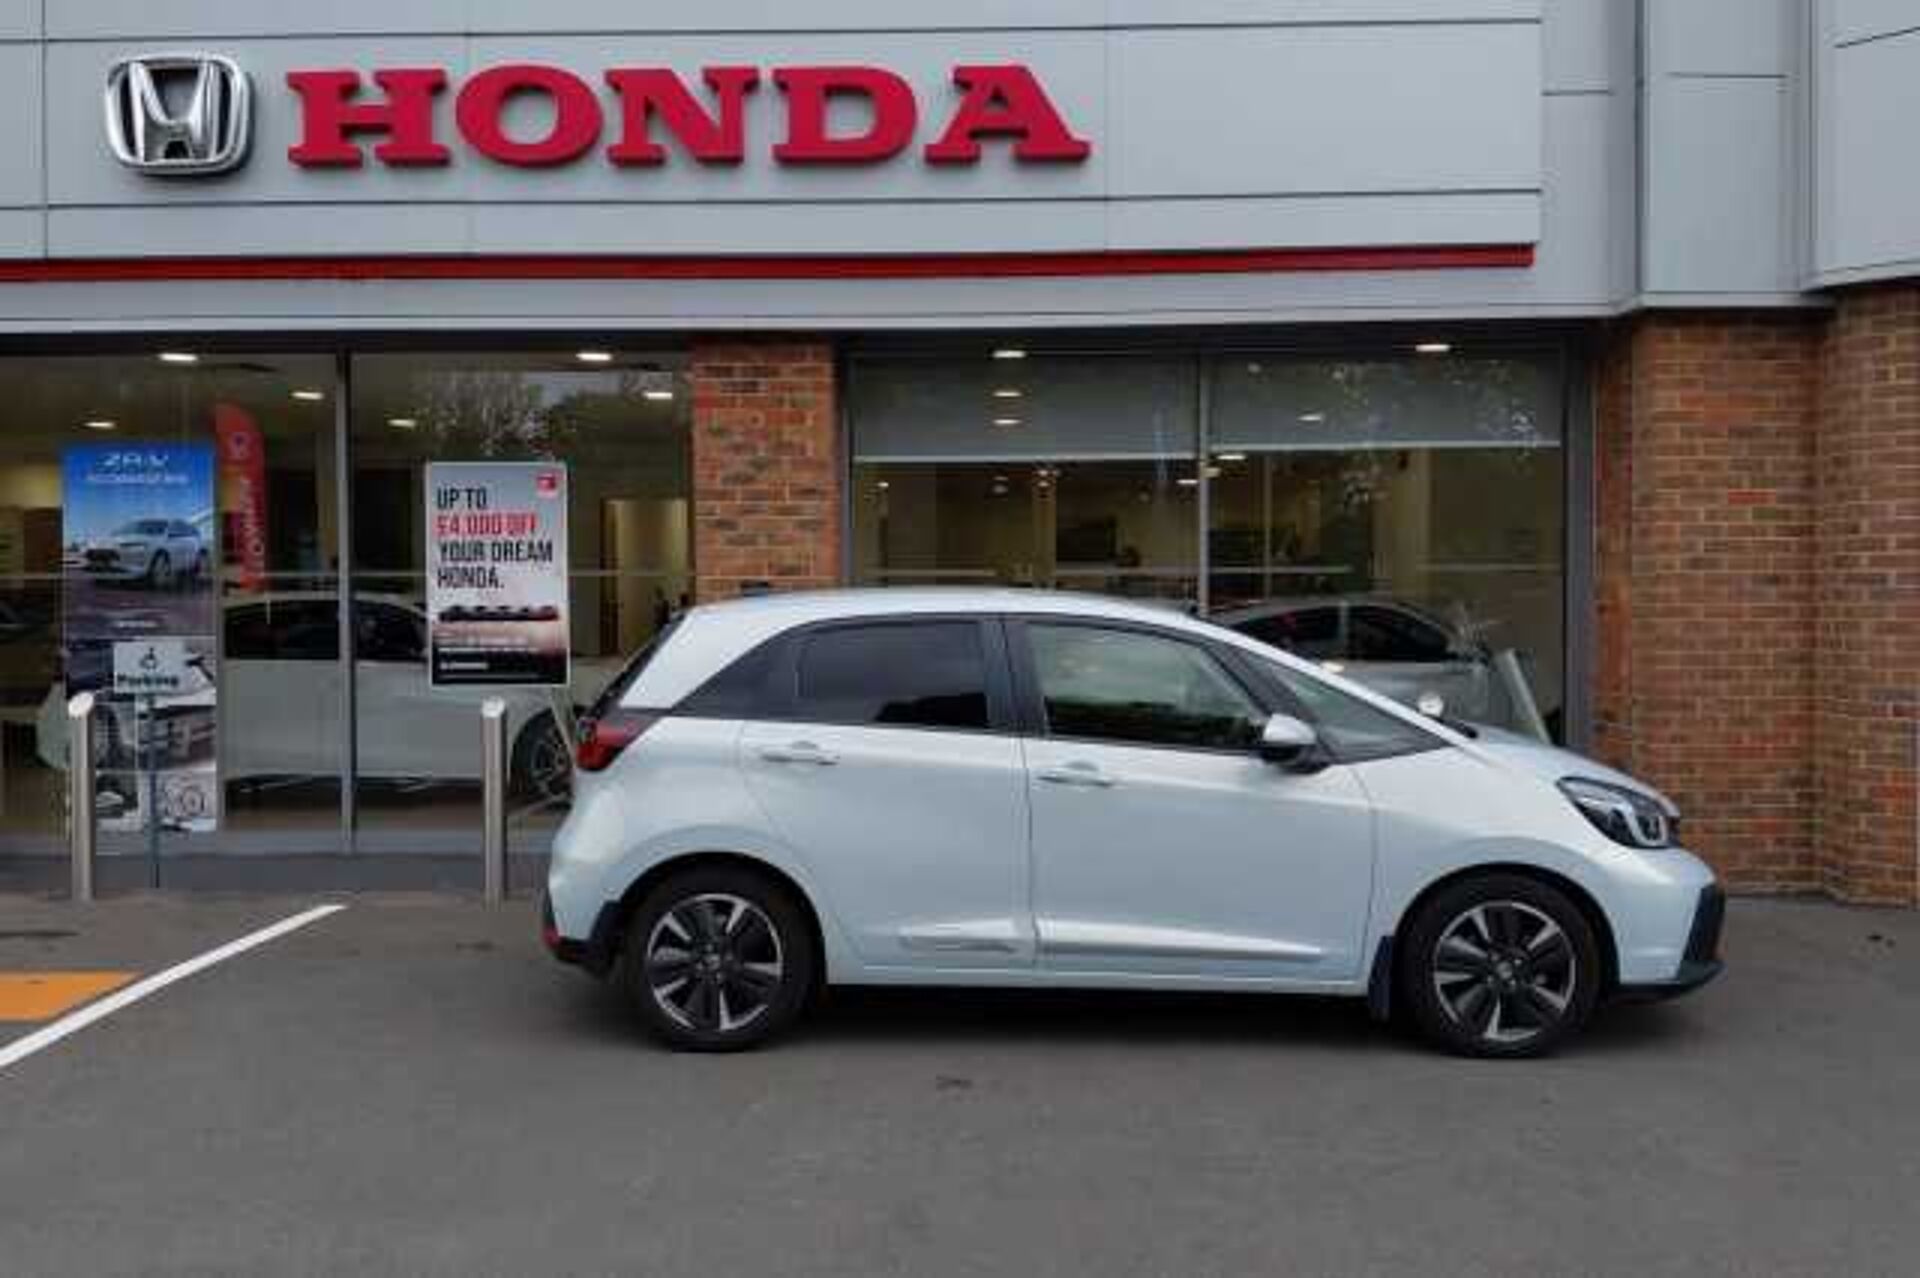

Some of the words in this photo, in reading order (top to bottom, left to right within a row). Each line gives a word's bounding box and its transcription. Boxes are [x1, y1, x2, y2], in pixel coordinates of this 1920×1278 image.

[287, 64, 1091, 168] HONDA
[437, 488, 459, 510] UP
[465, 488, 487, 510] TO
[439, 540, 485, 562] YOUR
[491, 540, 553, 562] DREAM
